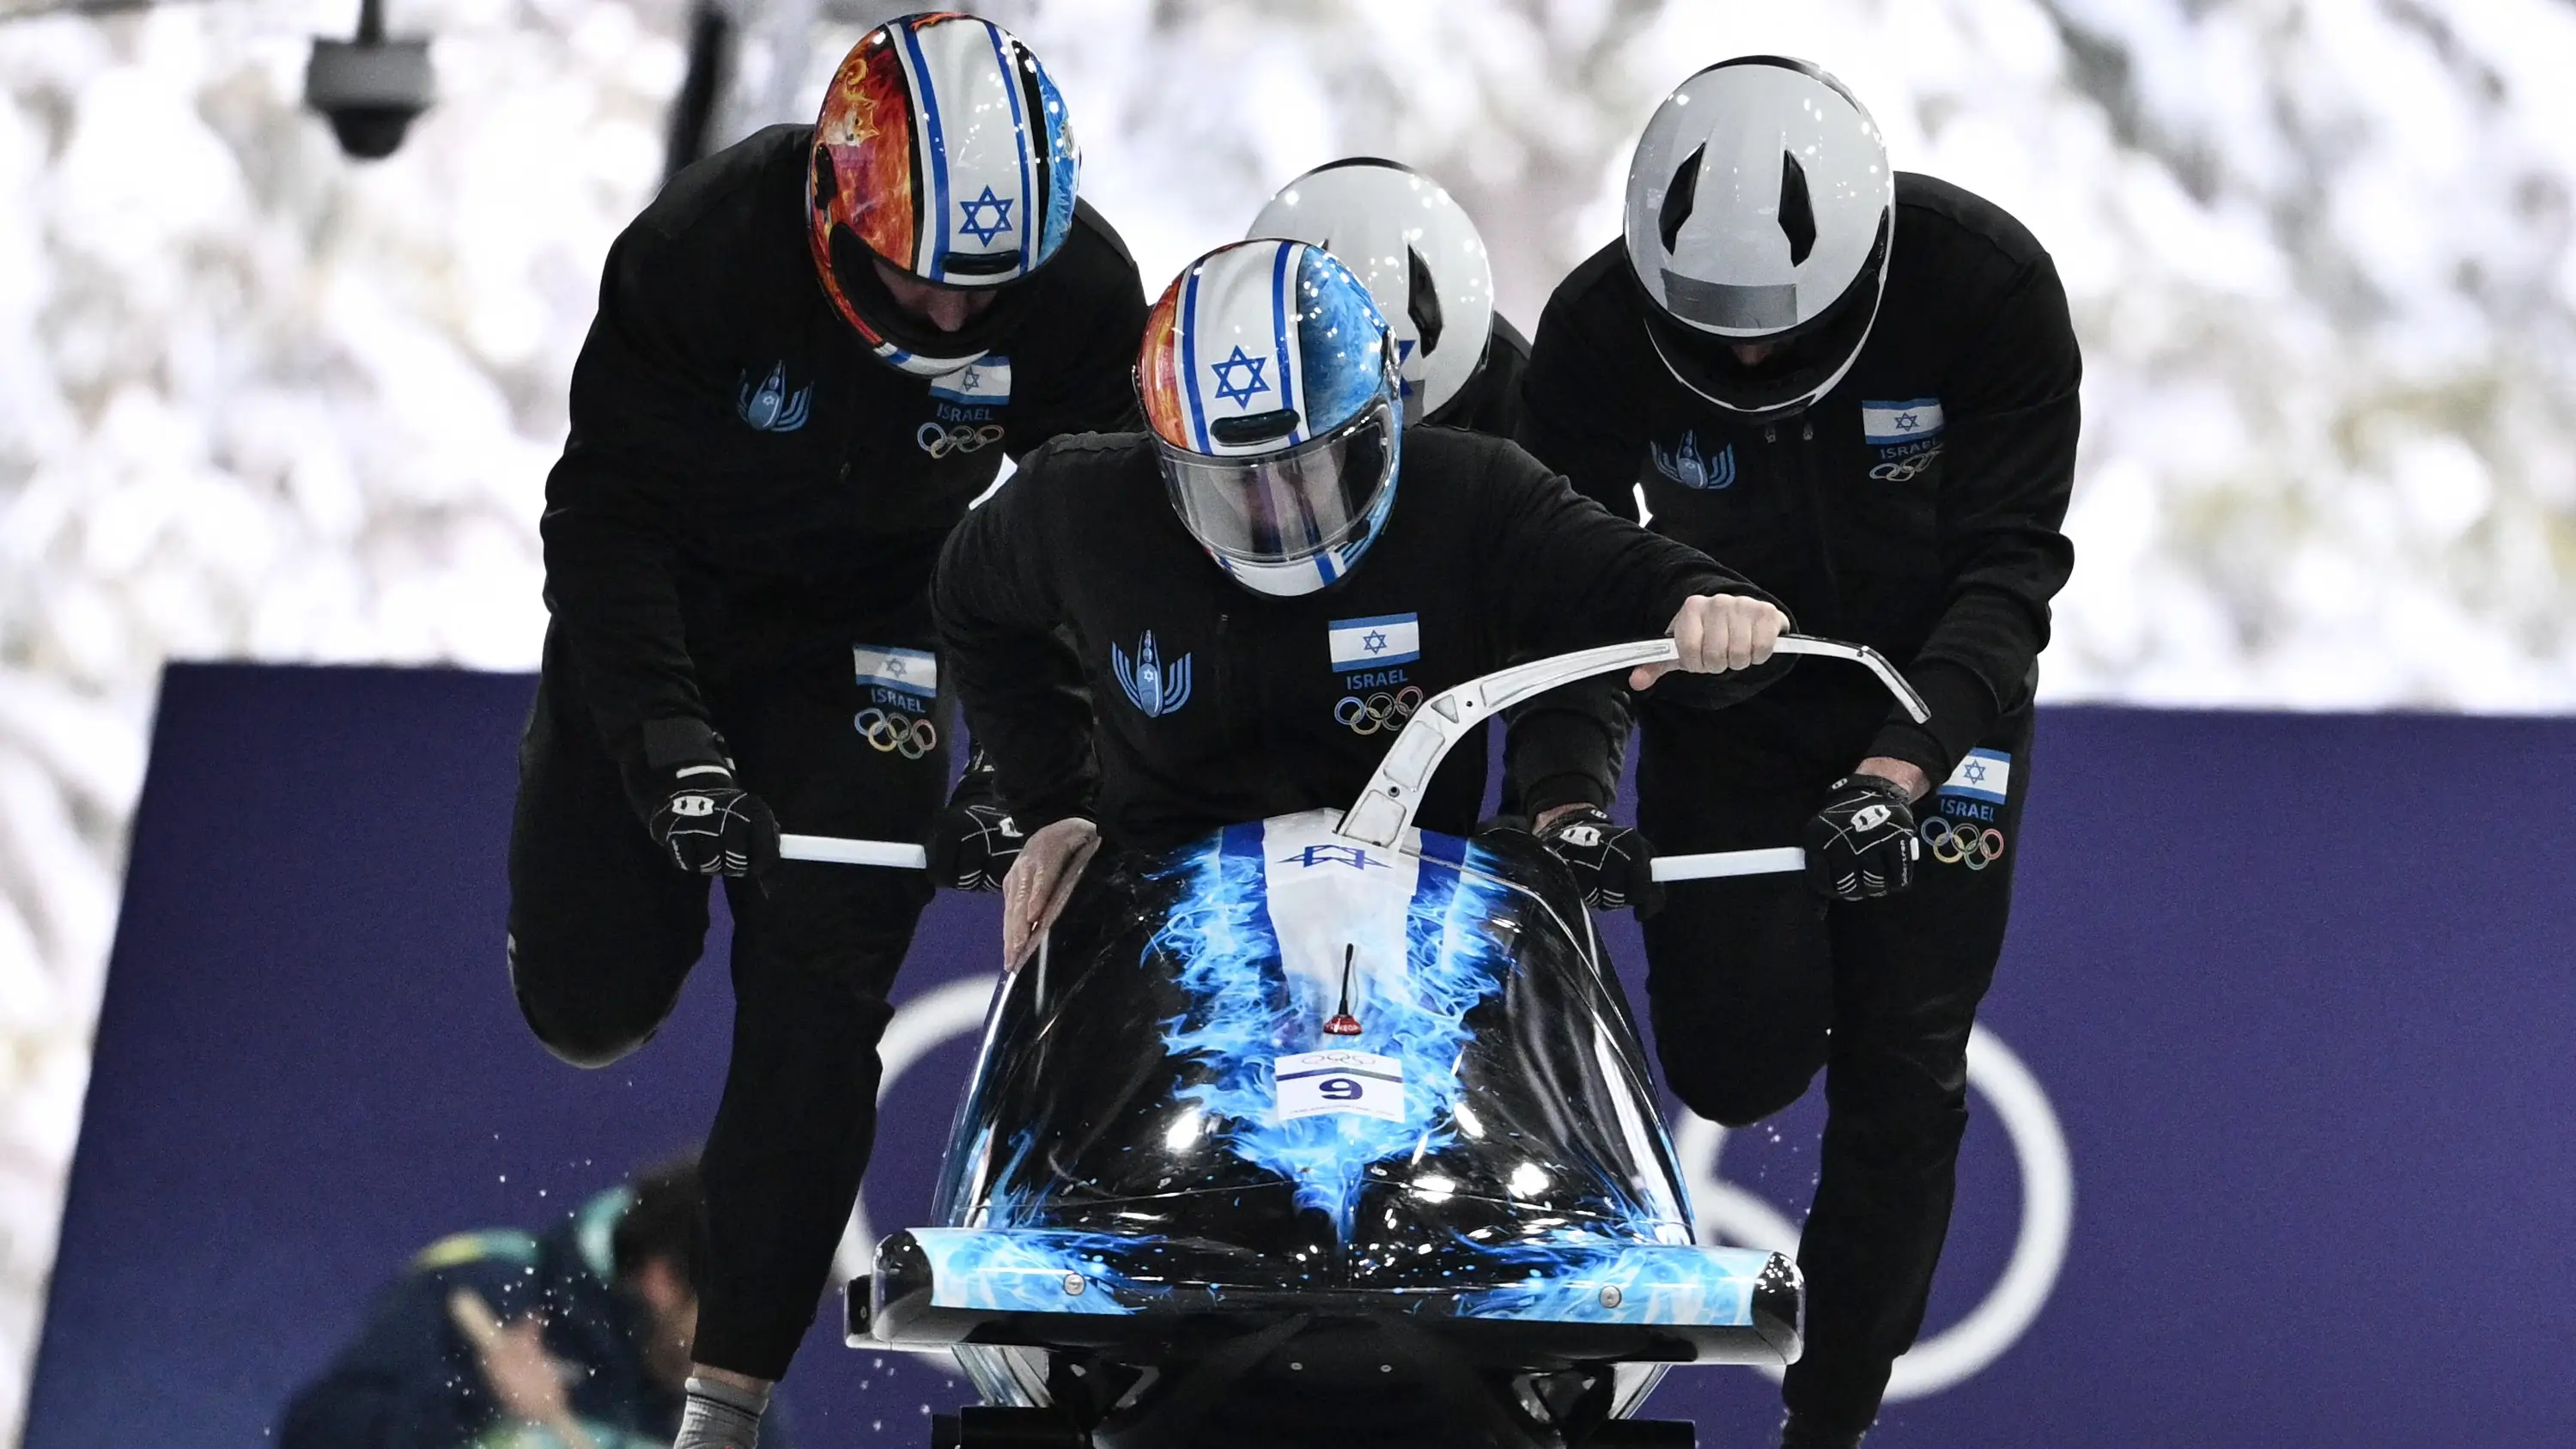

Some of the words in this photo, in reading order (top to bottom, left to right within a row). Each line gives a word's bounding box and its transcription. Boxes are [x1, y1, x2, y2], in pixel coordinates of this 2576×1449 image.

[937, 402, 993, 422] ISRAEL
[1346, 669, 1409, 691] ISRAEL
[871, 687, 927, 713] ISRAEL
[1941, 798, 1995, 823] ISRAEL
[1319, 1078, 1364, 1100] 9
